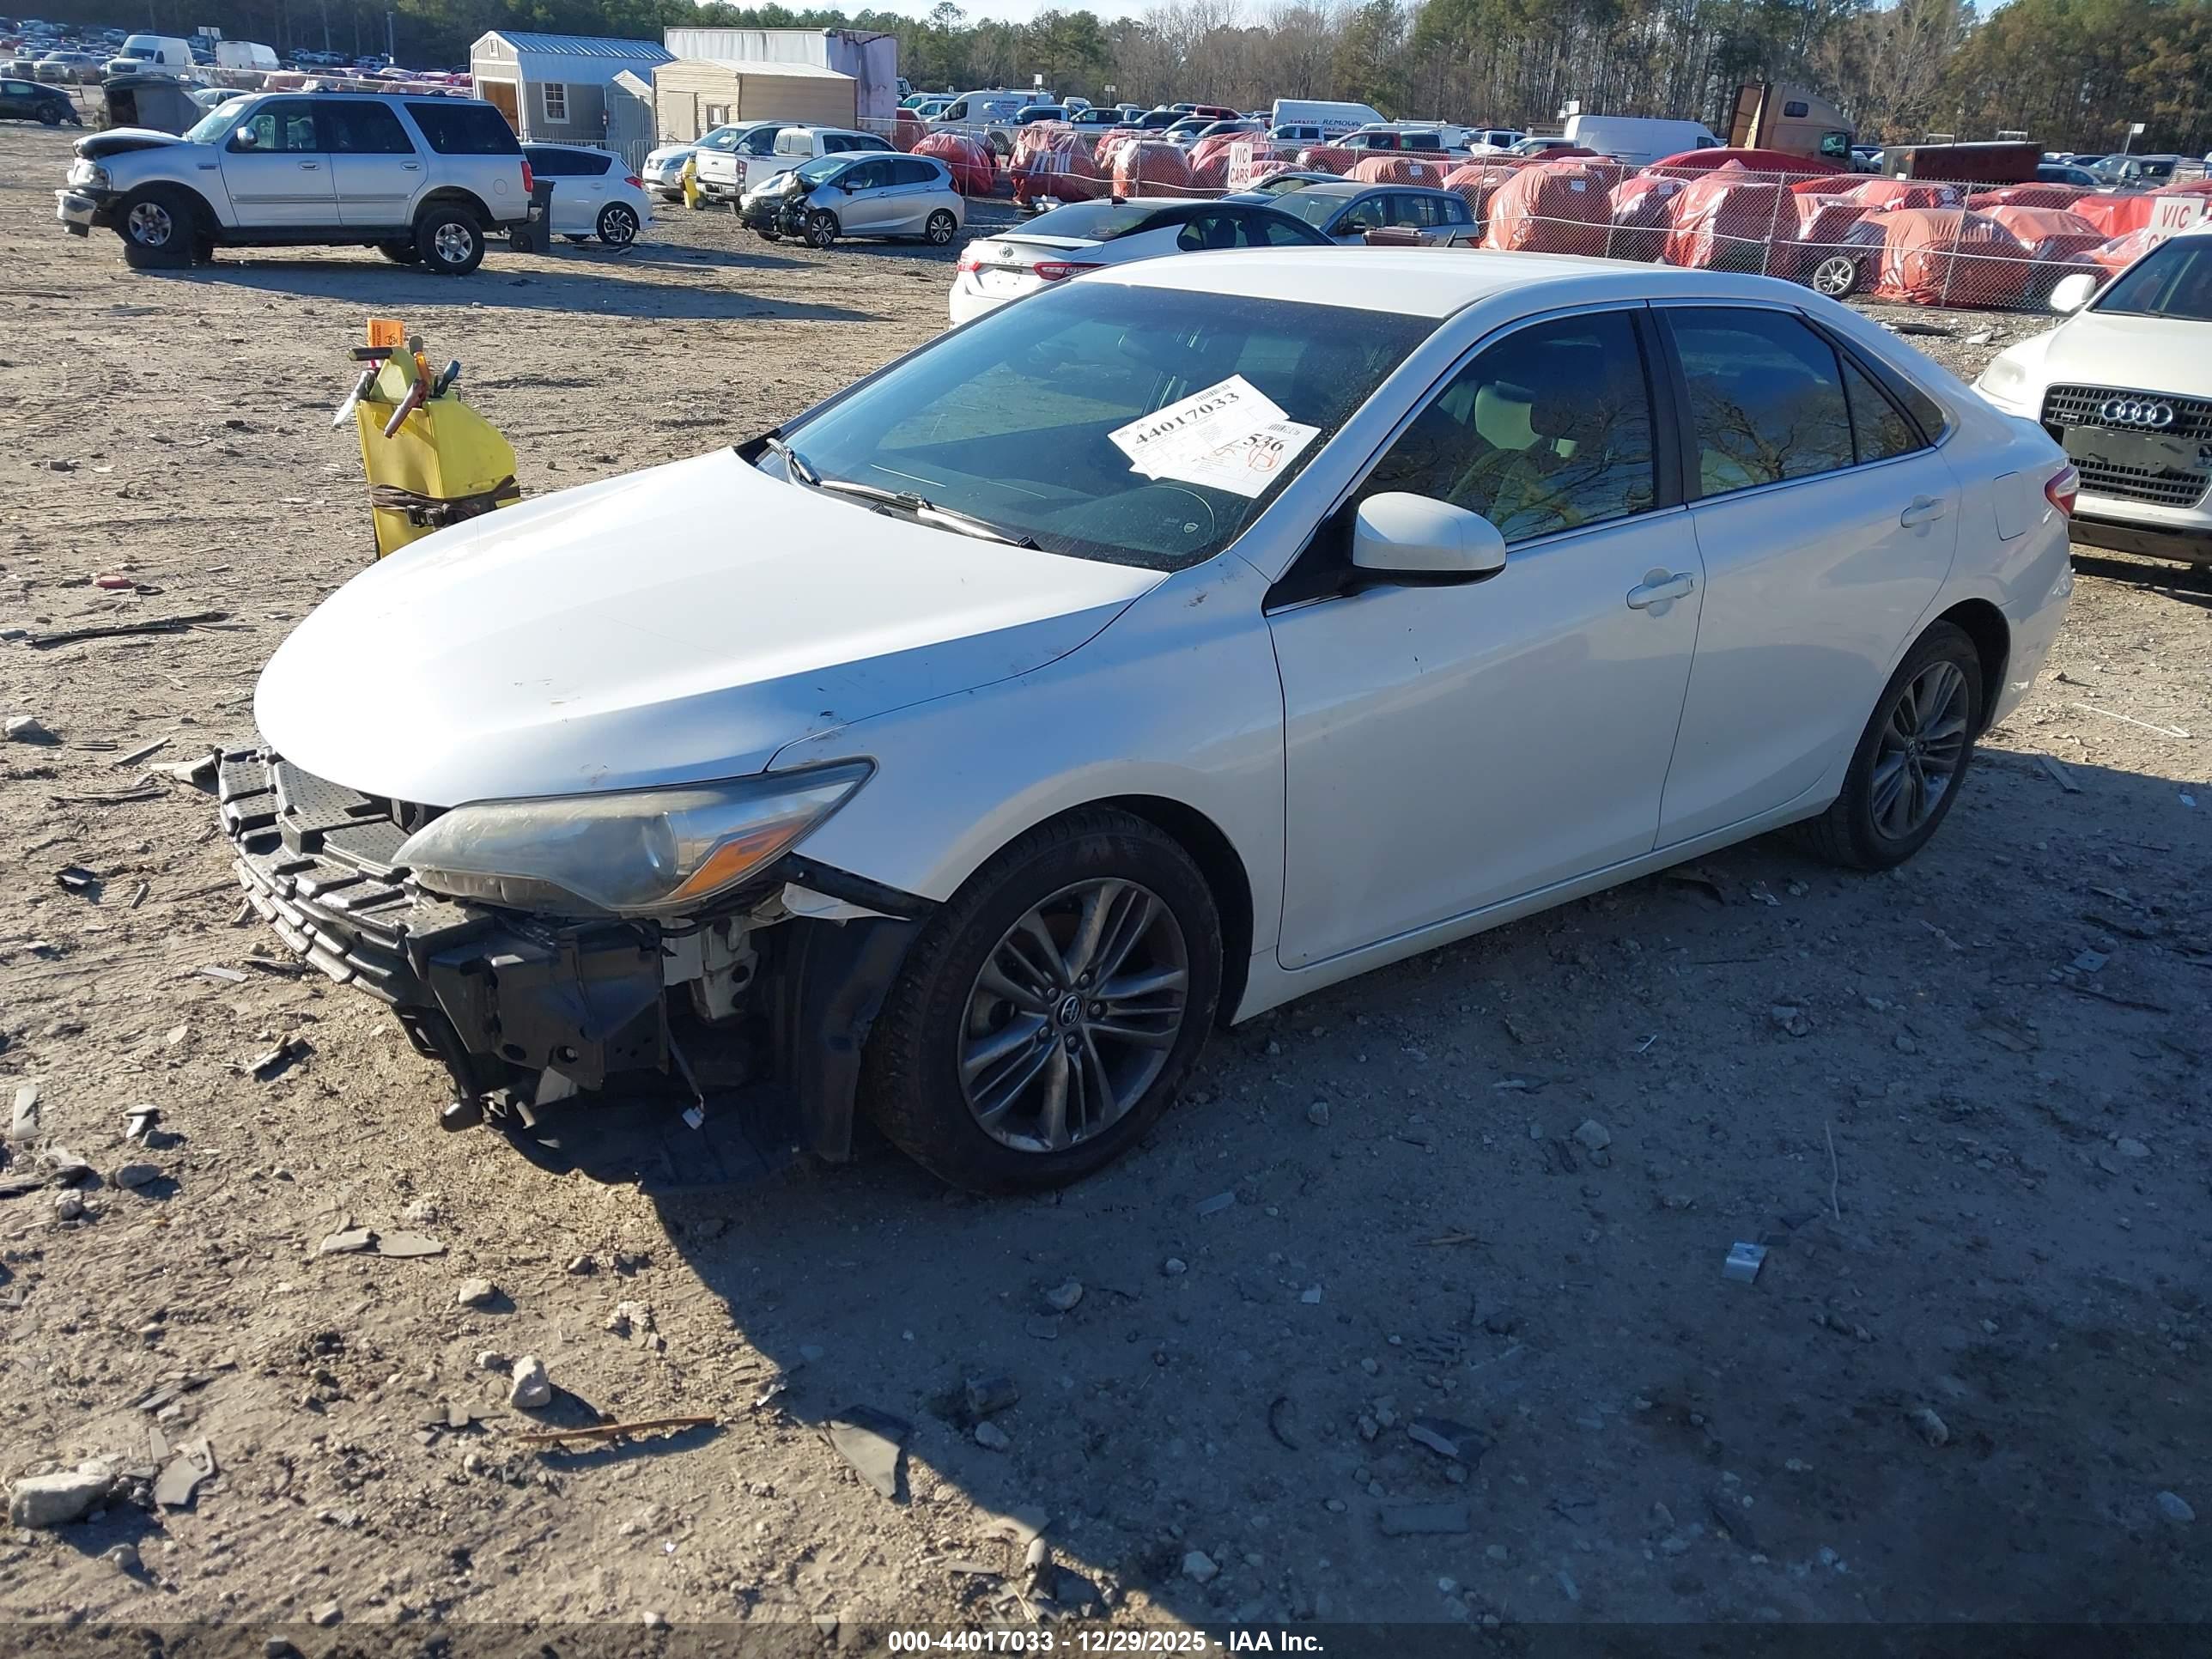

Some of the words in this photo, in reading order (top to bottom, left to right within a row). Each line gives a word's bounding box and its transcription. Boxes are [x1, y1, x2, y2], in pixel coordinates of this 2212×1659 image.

[1235, 147, 1249, 164] VIC
[1230, 167, 1249, 185] CARS
[2162, 205, 2191, 228] VIC
[1136, 392, 1240, 445] 44017033
[1243, 433, 1290, 452] 536
